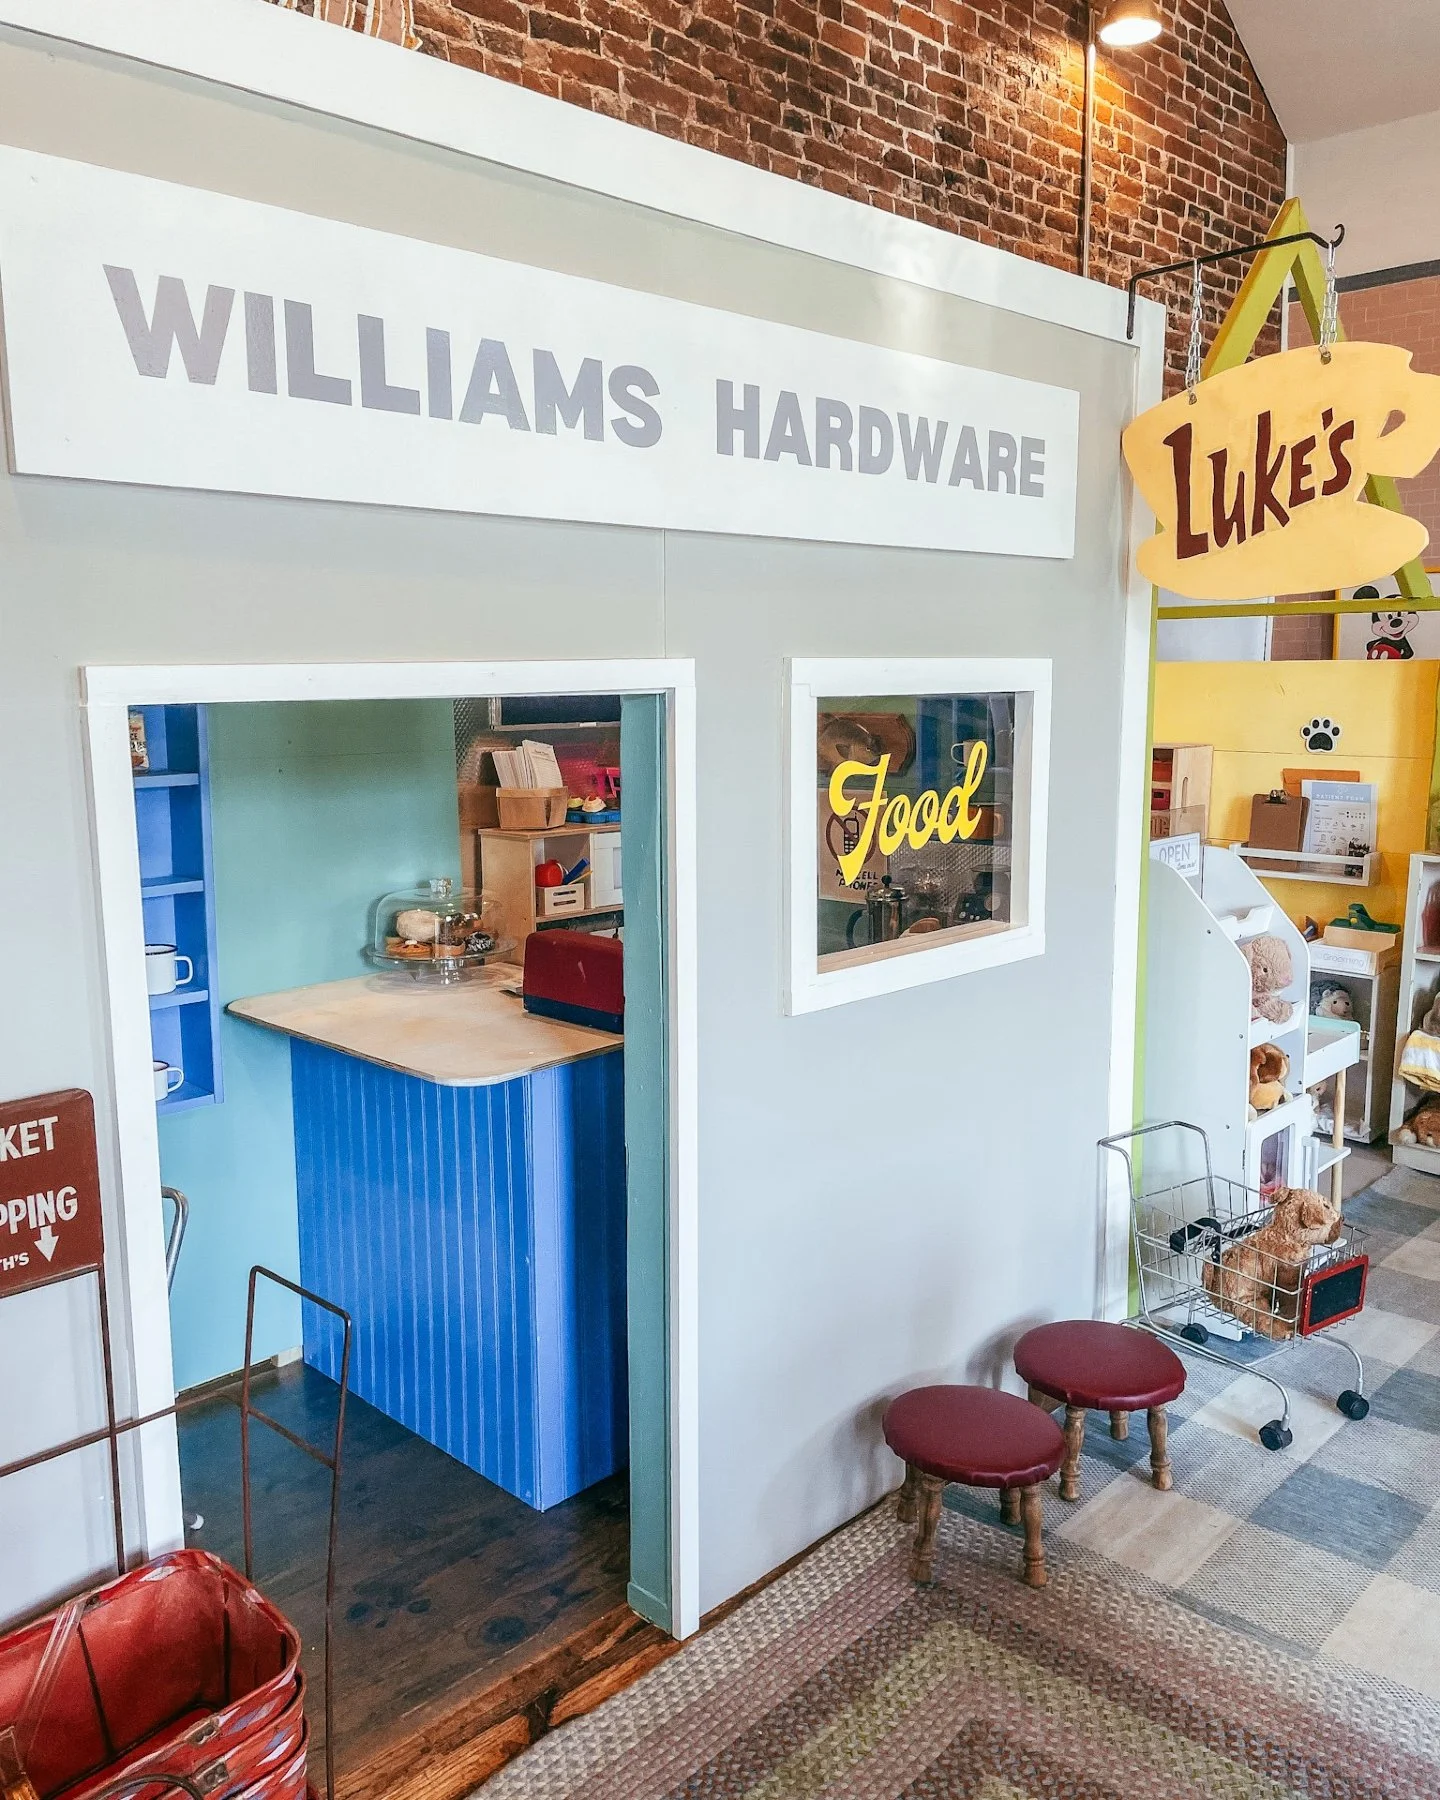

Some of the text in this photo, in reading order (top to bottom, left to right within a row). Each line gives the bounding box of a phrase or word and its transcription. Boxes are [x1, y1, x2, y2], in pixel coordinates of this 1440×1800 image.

[102, 263, 1045, 498] WILLIAMS HARDWARE
[829, 740, 988, 887] Food
[1159, 842, 1191, 864] OPEN
